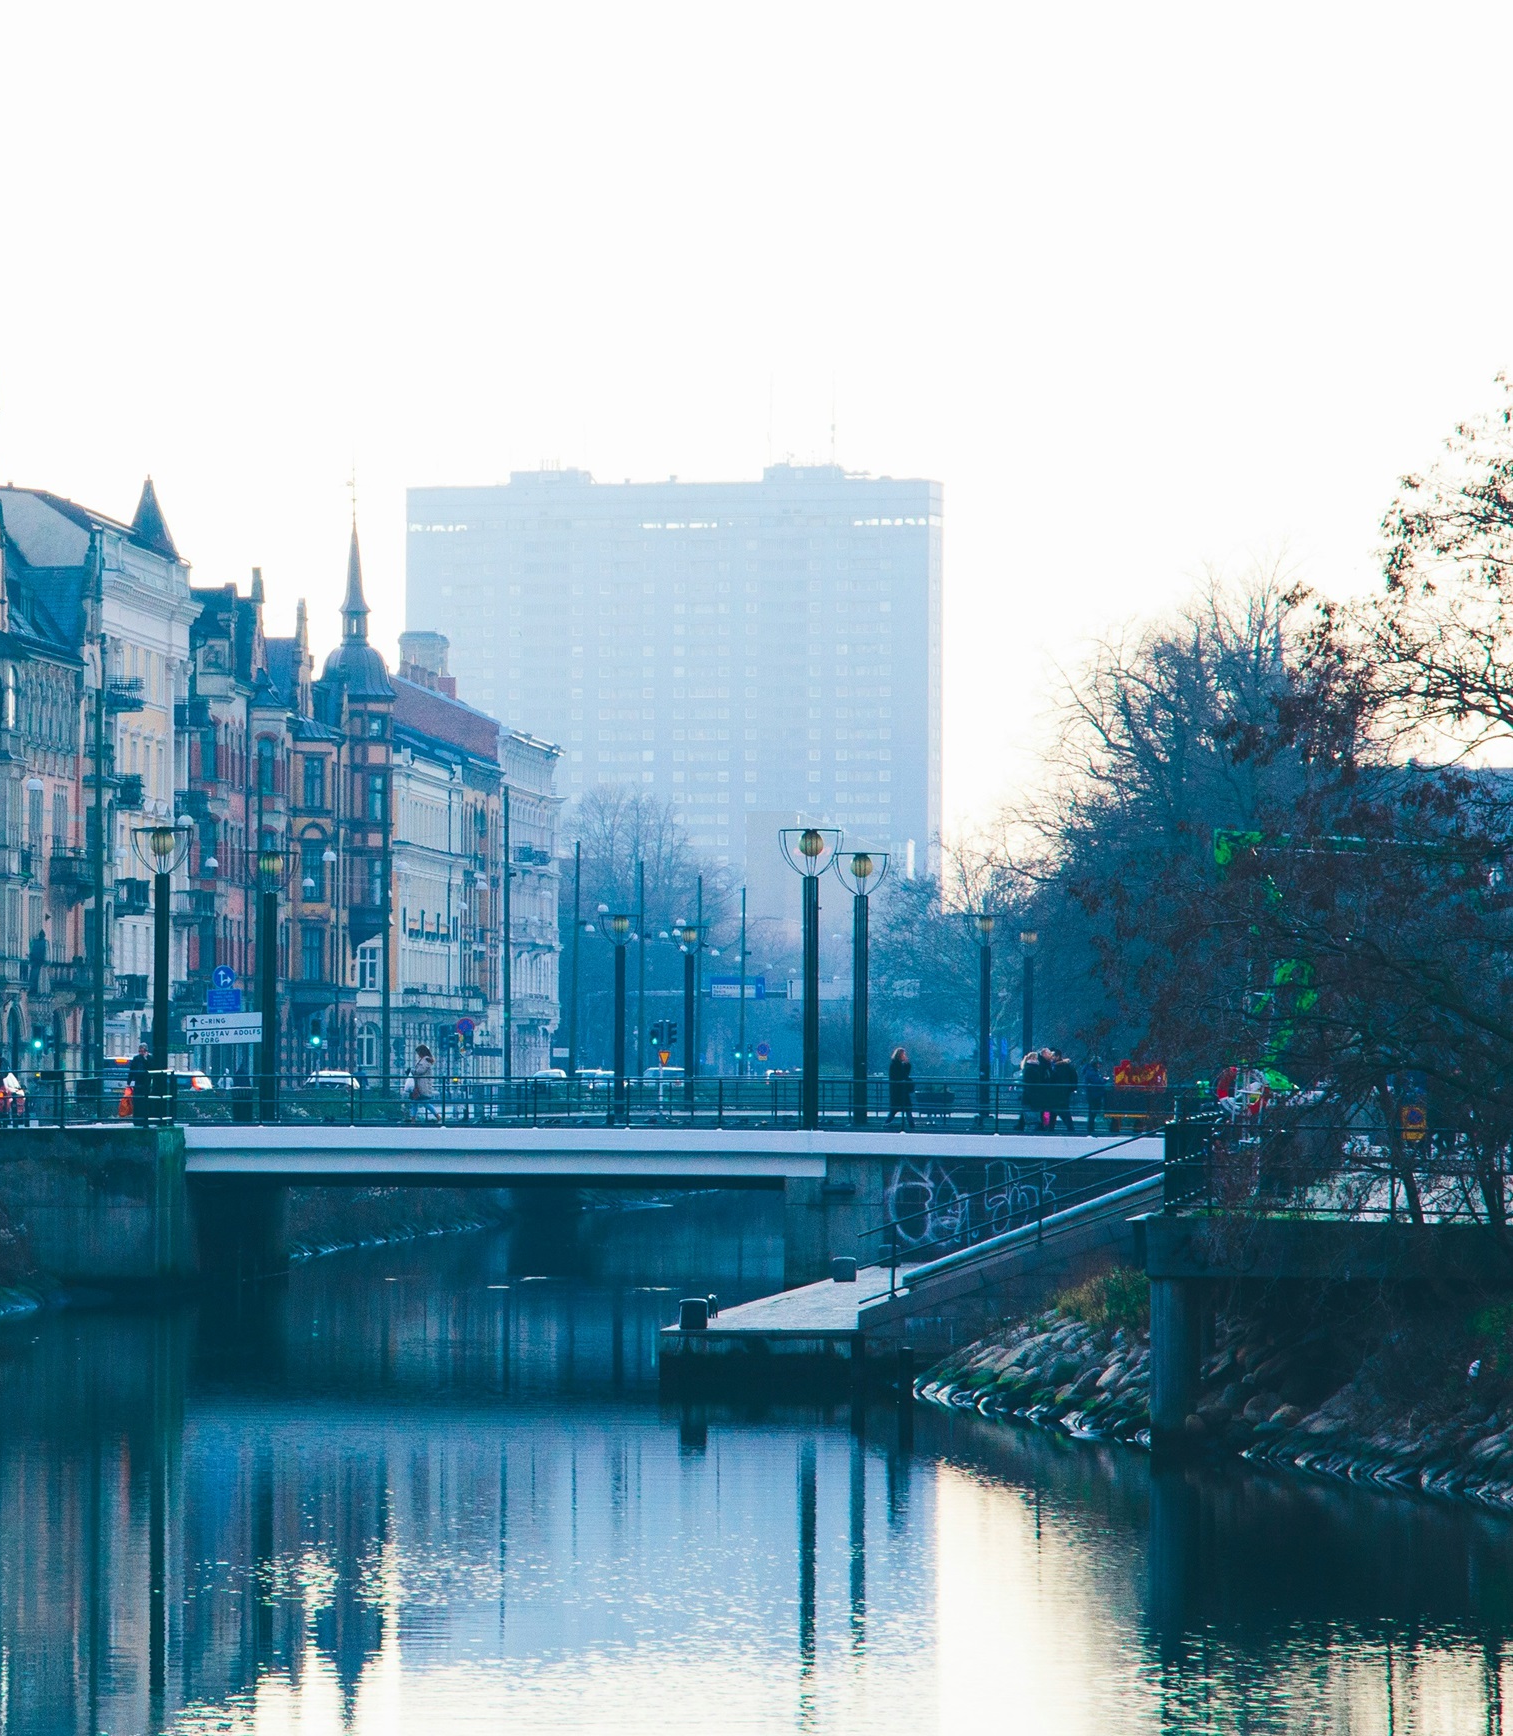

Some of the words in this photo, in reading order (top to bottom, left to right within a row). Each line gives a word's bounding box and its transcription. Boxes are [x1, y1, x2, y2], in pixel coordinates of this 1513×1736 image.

[200, 1017, 227, 1026] C-RING
[200, 1030, 230, 1038] GUSTAV
[233, 1028, 262, 1036] ADOLFS
